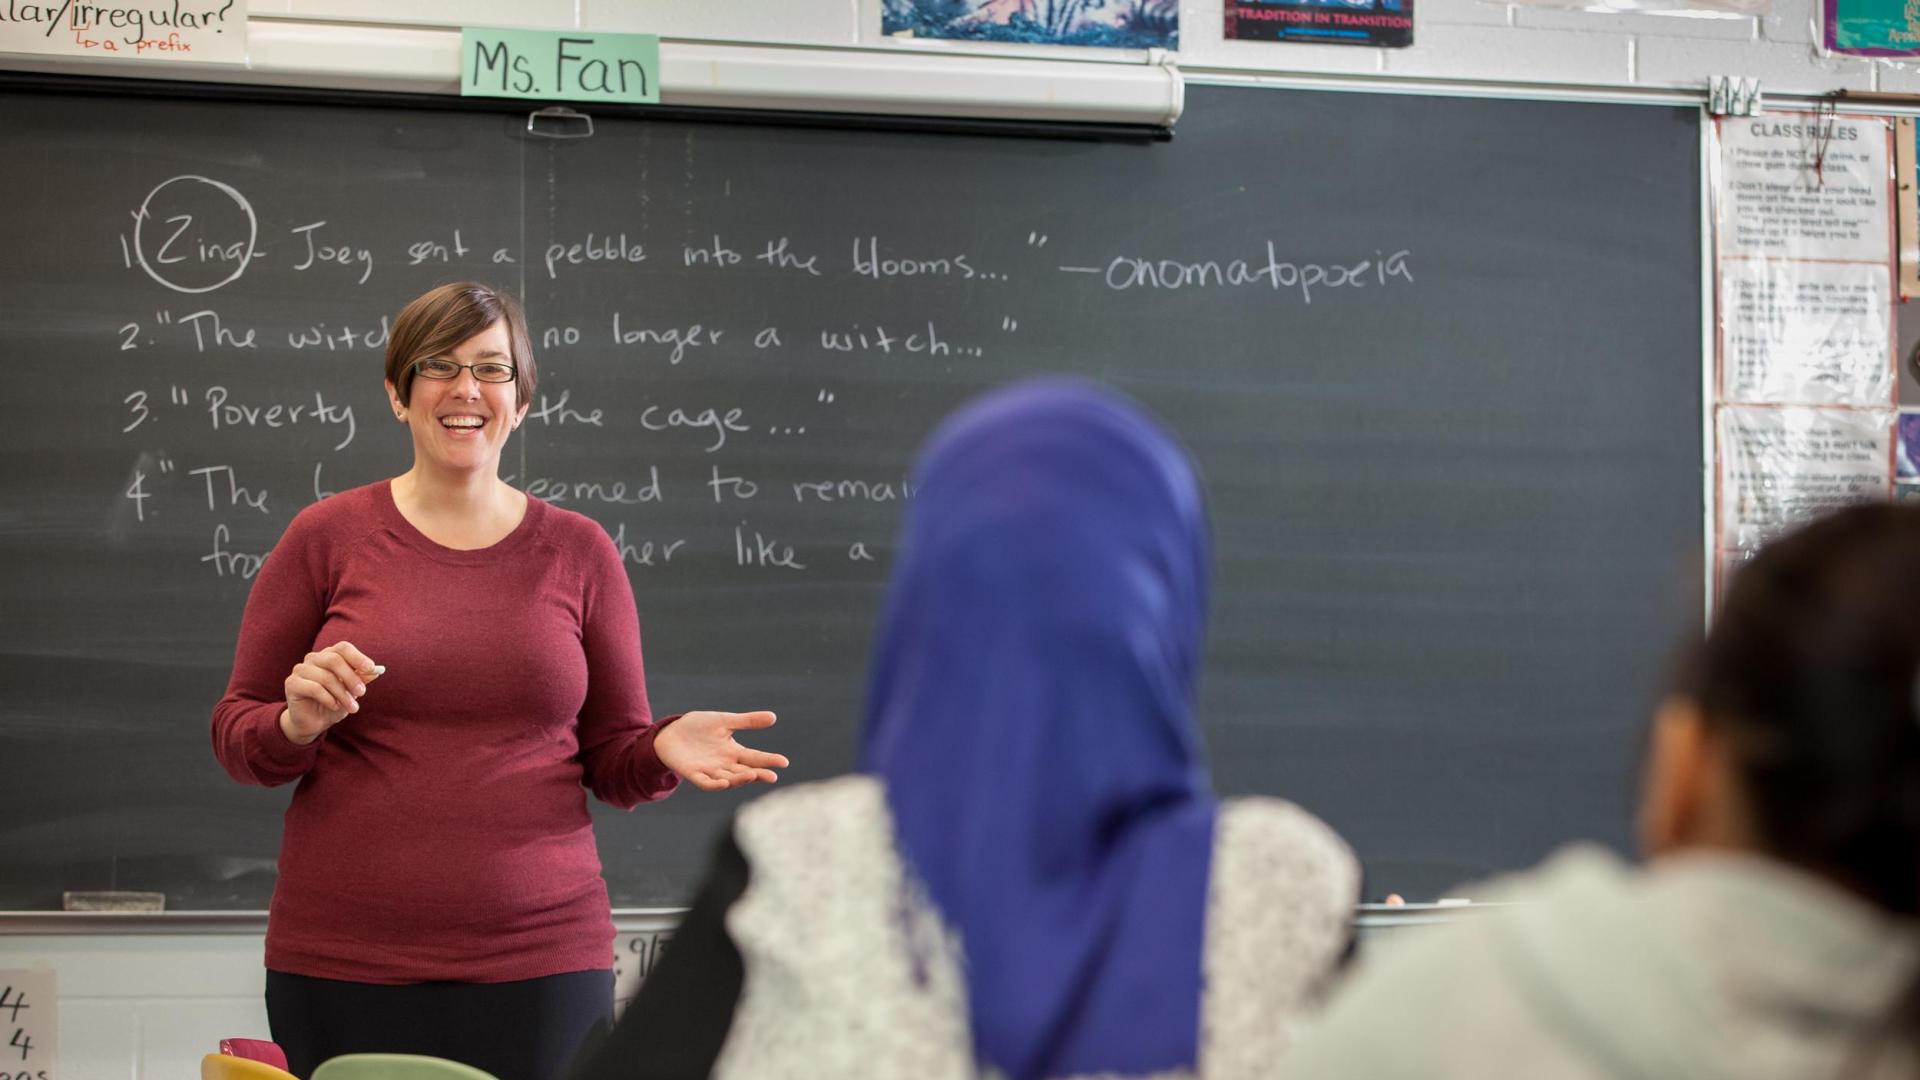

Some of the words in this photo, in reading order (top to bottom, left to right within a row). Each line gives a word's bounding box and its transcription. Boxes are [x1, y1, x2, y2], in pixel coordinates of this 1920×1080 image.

[1238, 8, 1311, 23] TRADITION
[1314, 13, 1330, 23] IN
[1333, 14, 1412, 28] TRANSITION
[103, 40, 118, 51] a
[136, 32, 192, 54] prefix
[473, 40, 540, 94] Ms.
[556, 38, 648, 97] Fan
[1750, 122, 1802, 139] CLASS
[1806, 126, 1858, 141] RULES
[291, 220, 373, 285] Joey
[408, 229, 470, 266] sent
[492, 248, 516, 264] a
[545, 233, 647, 280] pebble
[684, 235, 742, 267] into
[756, 236, 822, 277] the
[118, 322, 155, 351] 2.
[543, 326, 580, 349] no
[613, 311, 724, 365] longer
[754, 326, 782, 349] a
[122, 390, 159, 433] 3.
[528, 388, 604, 427] the
[503, 464, 663, 504] eemed
[707, 464, 758, 504] to
[201, 524, 272, 579] fro
[735, 519, 807, 570] like
[849, 542, 876, 561] a
[10, 1027, 35, 1061] 4
